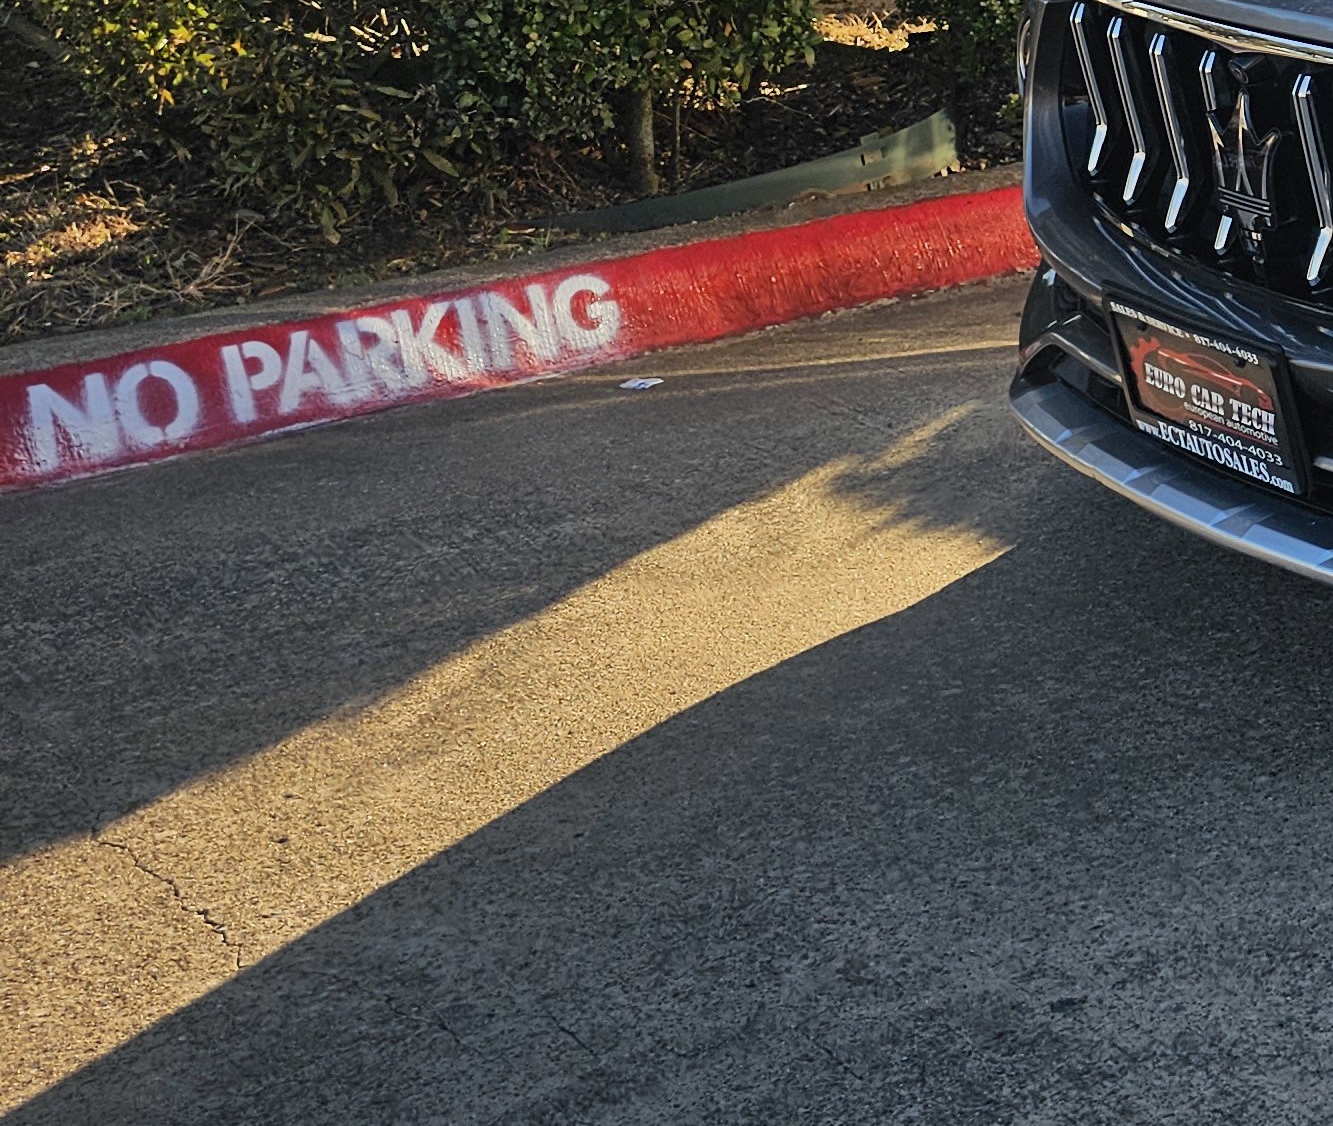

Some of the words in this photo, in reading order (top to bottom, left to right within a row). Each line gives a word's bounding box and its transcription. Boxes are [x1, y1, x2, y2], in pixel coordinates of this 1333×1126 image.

[1110, 301, 1138, 319] SALES
[1145, 316, 1184, 339] SERVICE
[1193, 333, 1260, 365] 817-404-4033
[22, 359, 200, 474] NO
[220, 274, 622, 424] PARKING
[1143, 362, 1186, 399] EURO
[1190, 384, 1225, 417] CAR
[1228, 397, 1276, 436] TECH
[1135, 419, 1296, 494] www.ECTAUTOSALES.com
[1184, 401, 1226, 424] european
[1226, 415, 1279, 446] automotive
[1188, 419, 1284, 466] 817-404-4033
